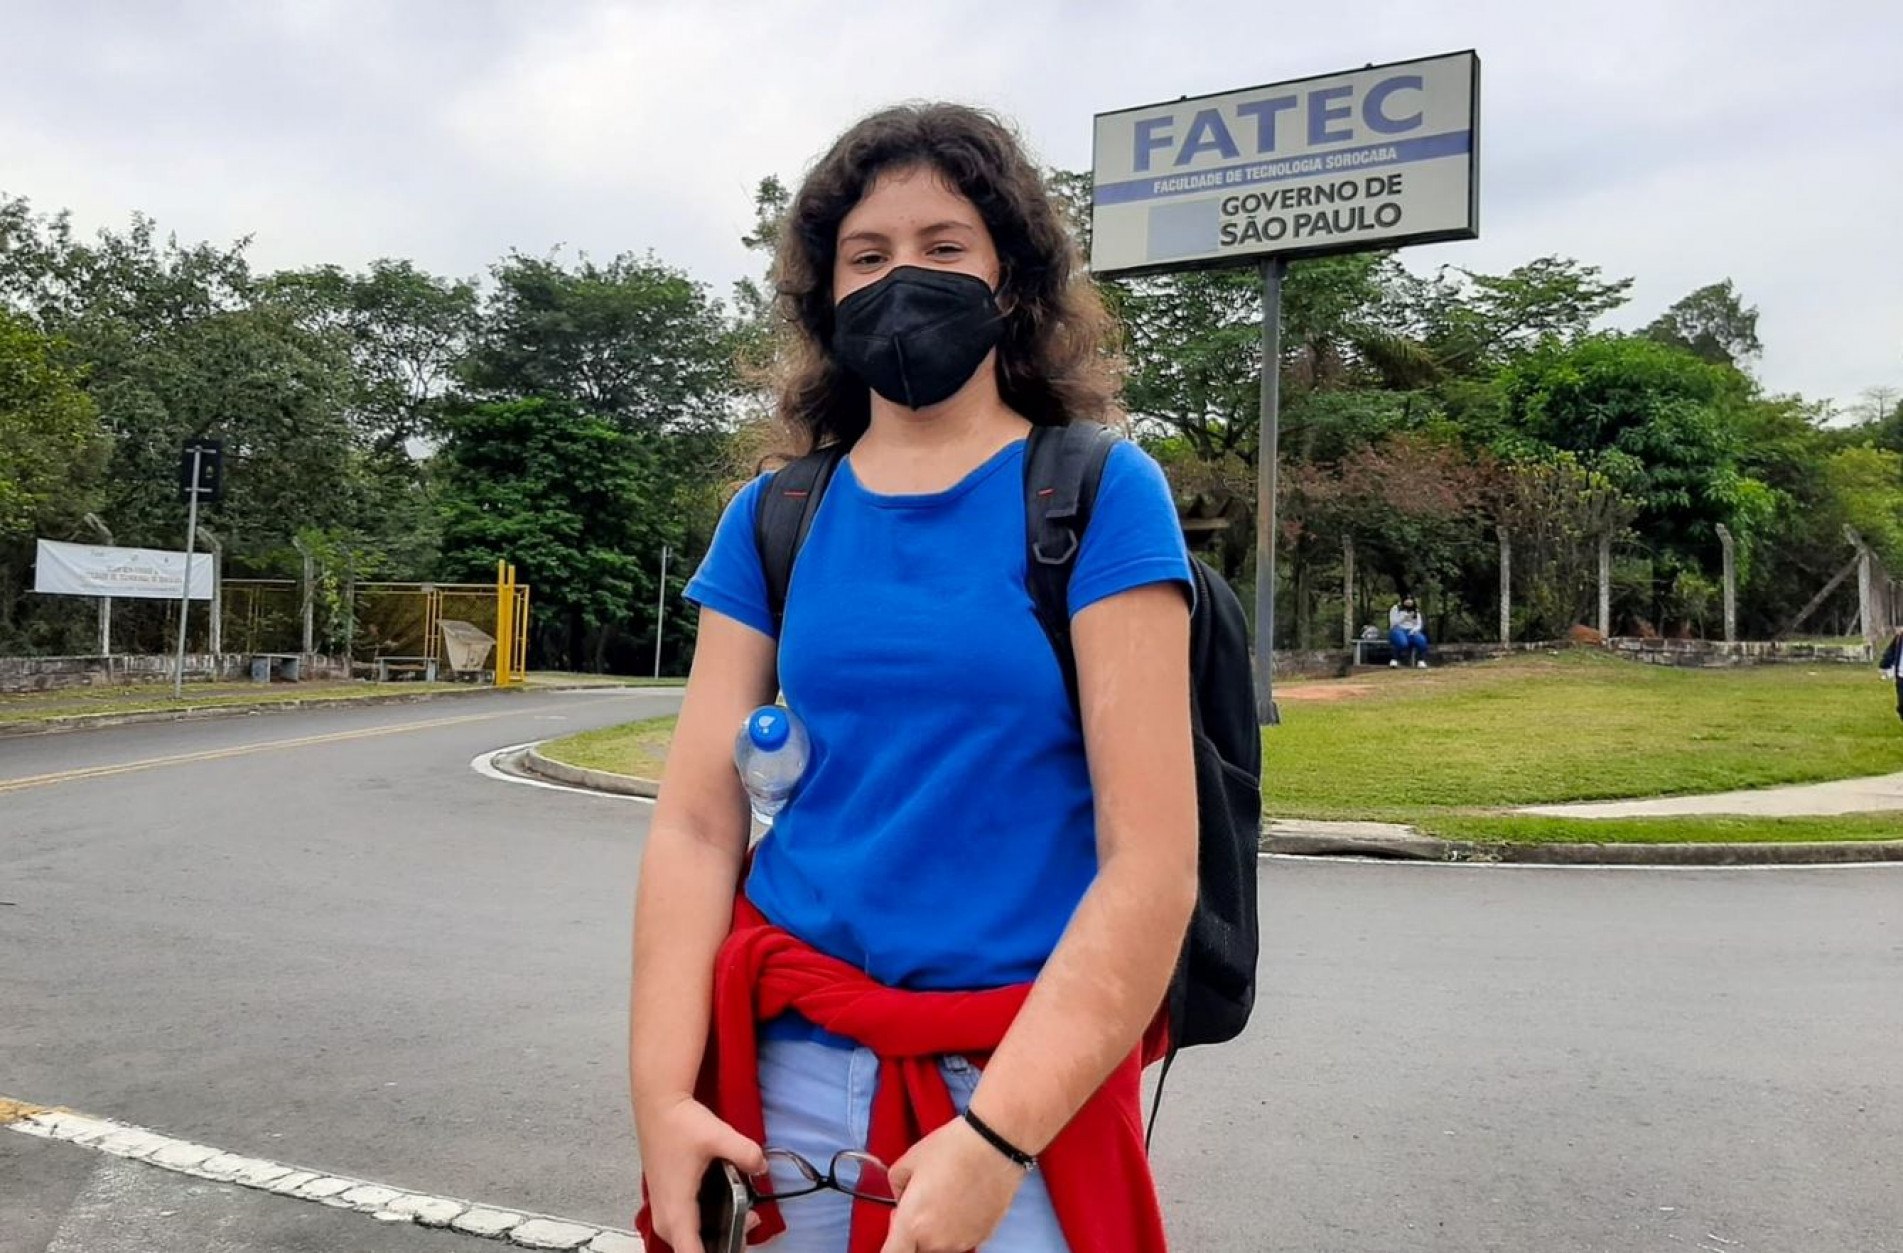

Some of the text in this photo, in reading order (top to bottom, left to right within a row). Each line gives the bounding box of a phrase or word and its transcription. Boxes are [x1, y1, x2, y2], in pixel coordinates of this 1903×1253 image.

[1134, 76, 1423, 171] FATEC
[1154, 148, 1397, 193] FACULDADE DE TECNOLOGIA SOROCABA
[1222, 174, 1402, 217] GOVERNO DE
[1220, 203, 1401, 246] SÃO PAULO
